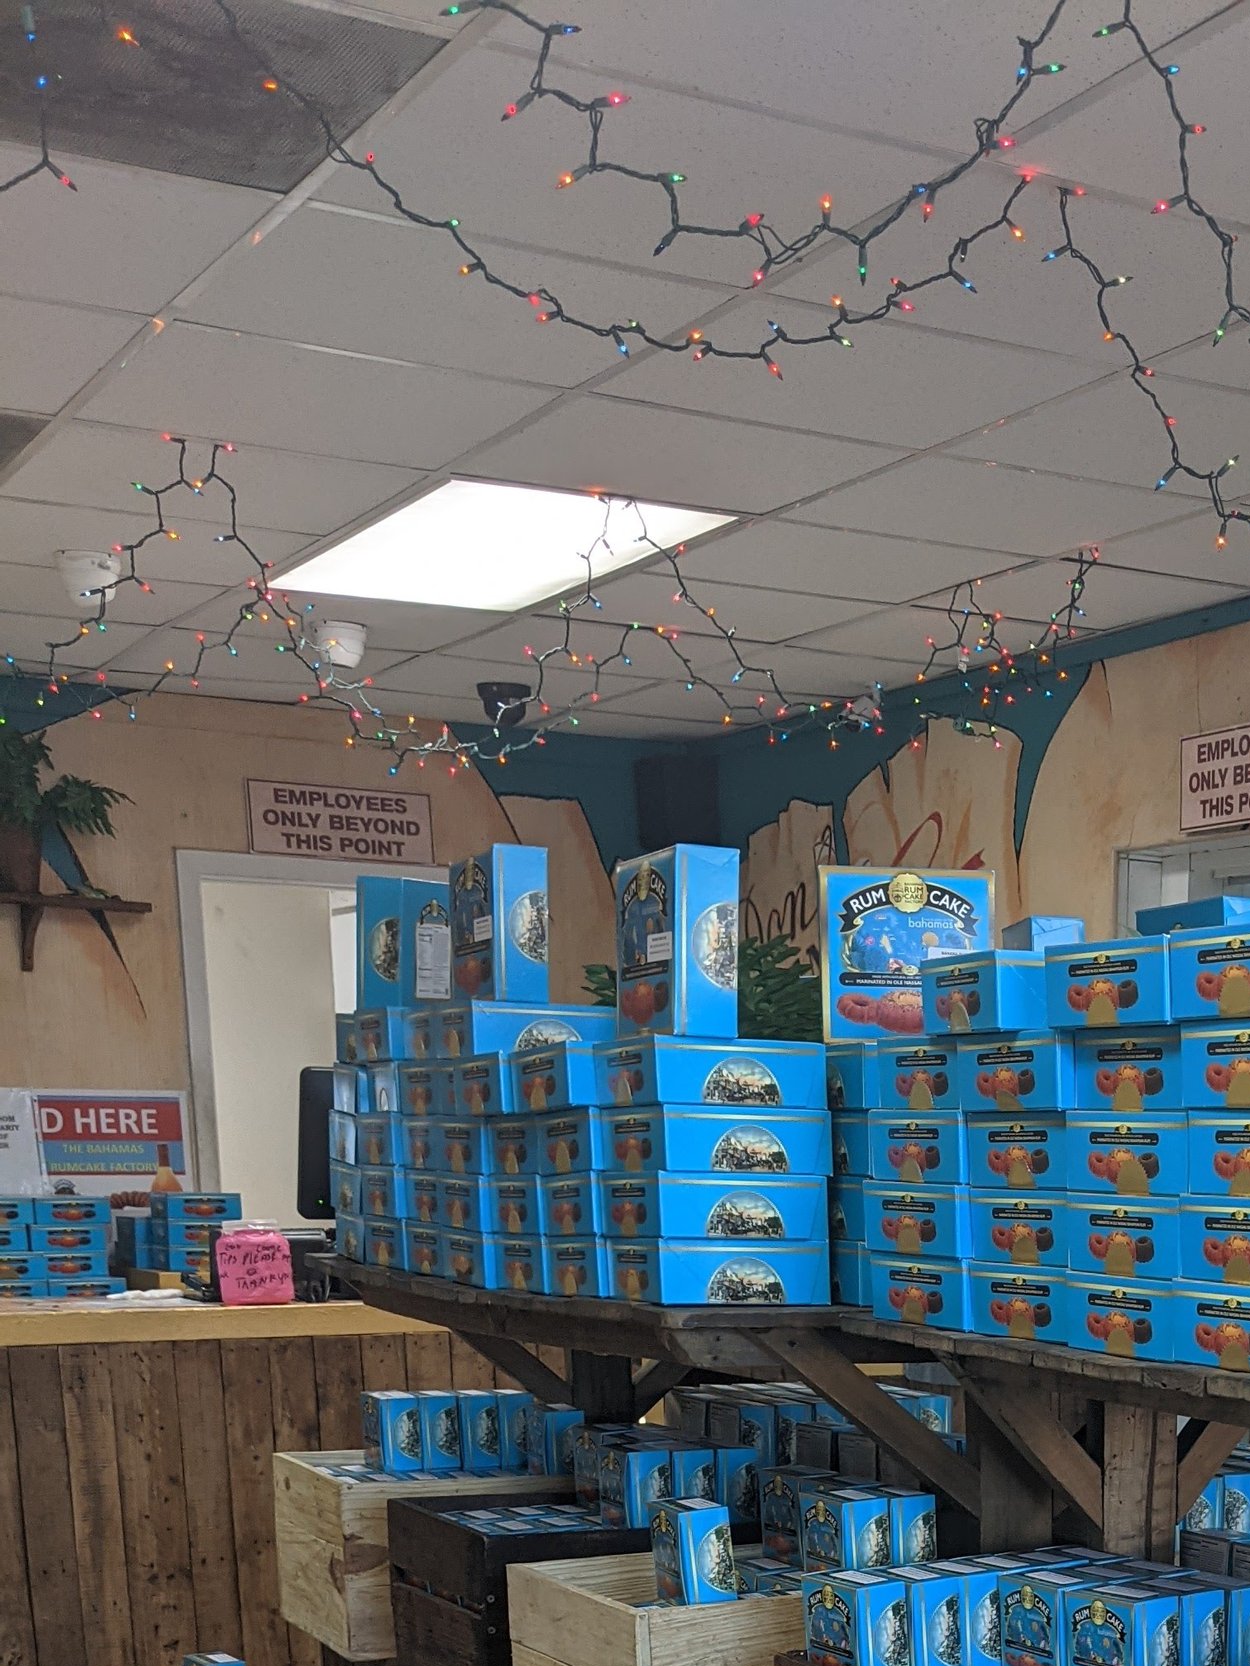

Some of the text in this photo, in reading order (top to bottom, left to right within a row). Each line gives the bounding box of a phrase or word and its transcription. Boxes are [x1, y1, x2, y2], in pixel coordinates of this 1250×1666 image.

[1189, 767, 1228, 793] ONLY
[273, 788, 407, 814] EMPLOYEES
[1200, 795, 1234, 818] THIS
[263, 809, 420, 836] ONLY BEYOND
[281, 833, 405, 857] THIS POINT
[904, 886, 923, 894] RUM
[850, 888, 971, 918] RUM CAKE
[908, 917, 954, 929] bahamas
[75, 1108, 159, 1134] HERE
[63, 1144, 145, 1154] THE BAHAMAS
[51, 1163, 160, 1172] RUMCAKE FACTORY
[1075, 1608, 1090, 1623] RUM
